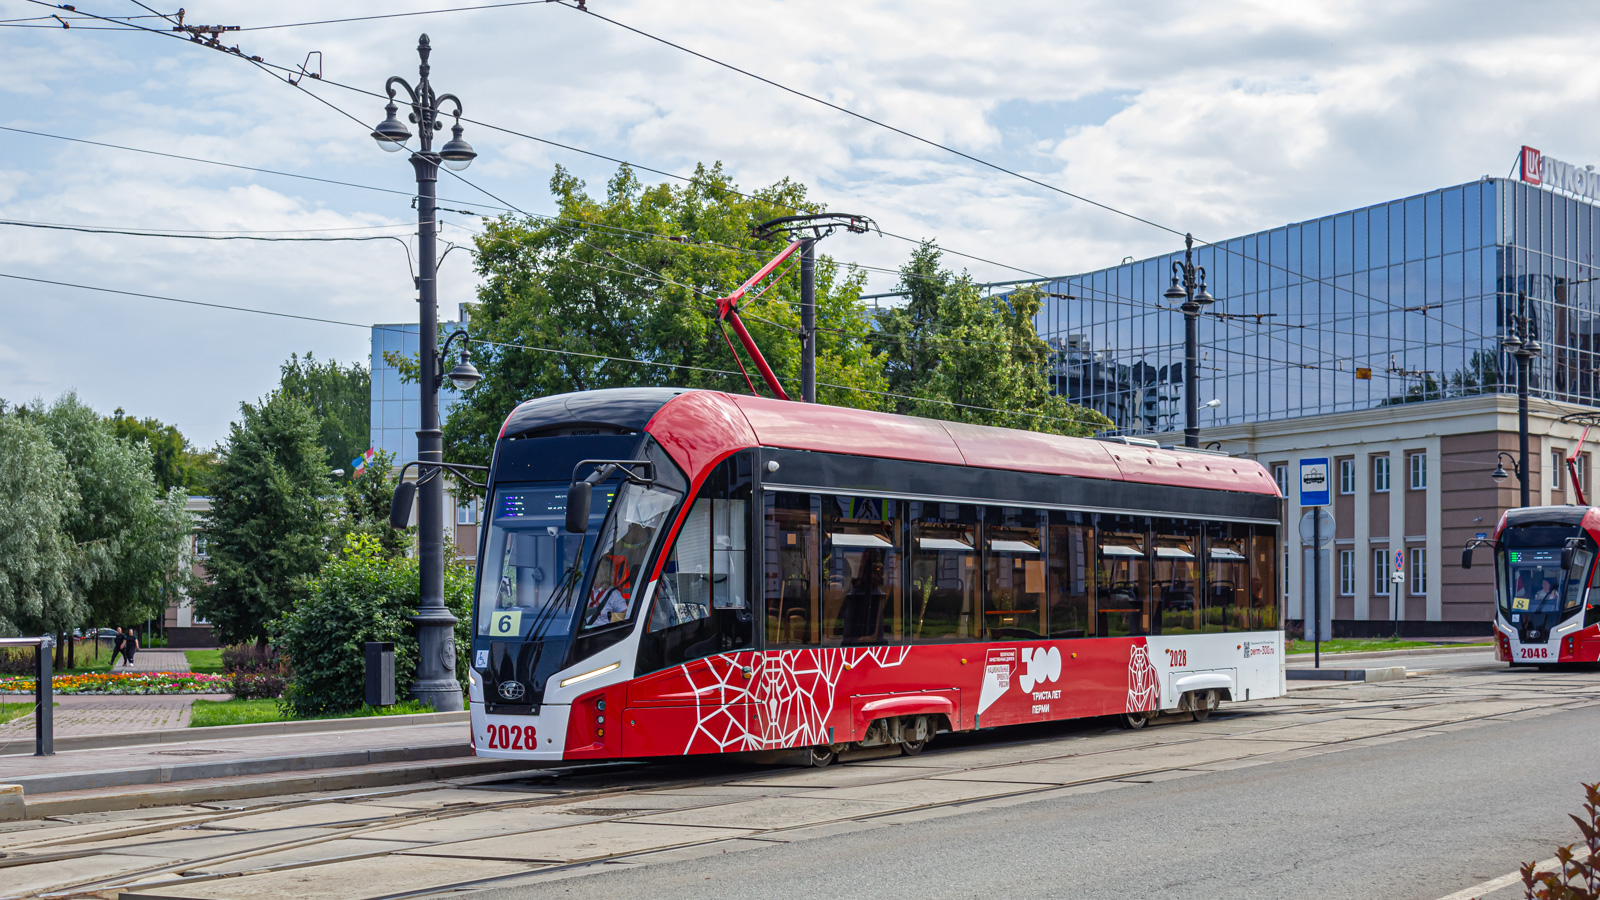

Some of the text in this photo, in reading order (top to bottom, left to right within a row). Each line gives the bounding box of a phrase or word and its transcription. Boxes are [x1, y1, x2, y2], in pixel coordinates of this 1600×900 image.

[1516, 600, 1524, 608] 8
[498, 615, 512, 632] 6
[1170, 650, 1186, 666] 2028
[1520, 648, 1548, 658] 2048
[1032, 690, 1062, 701] ТРИСТА ЛЕТ
[1032, 704, 1050, 714] ПЕРМИ
[486, 724, 538, 750] 2028
